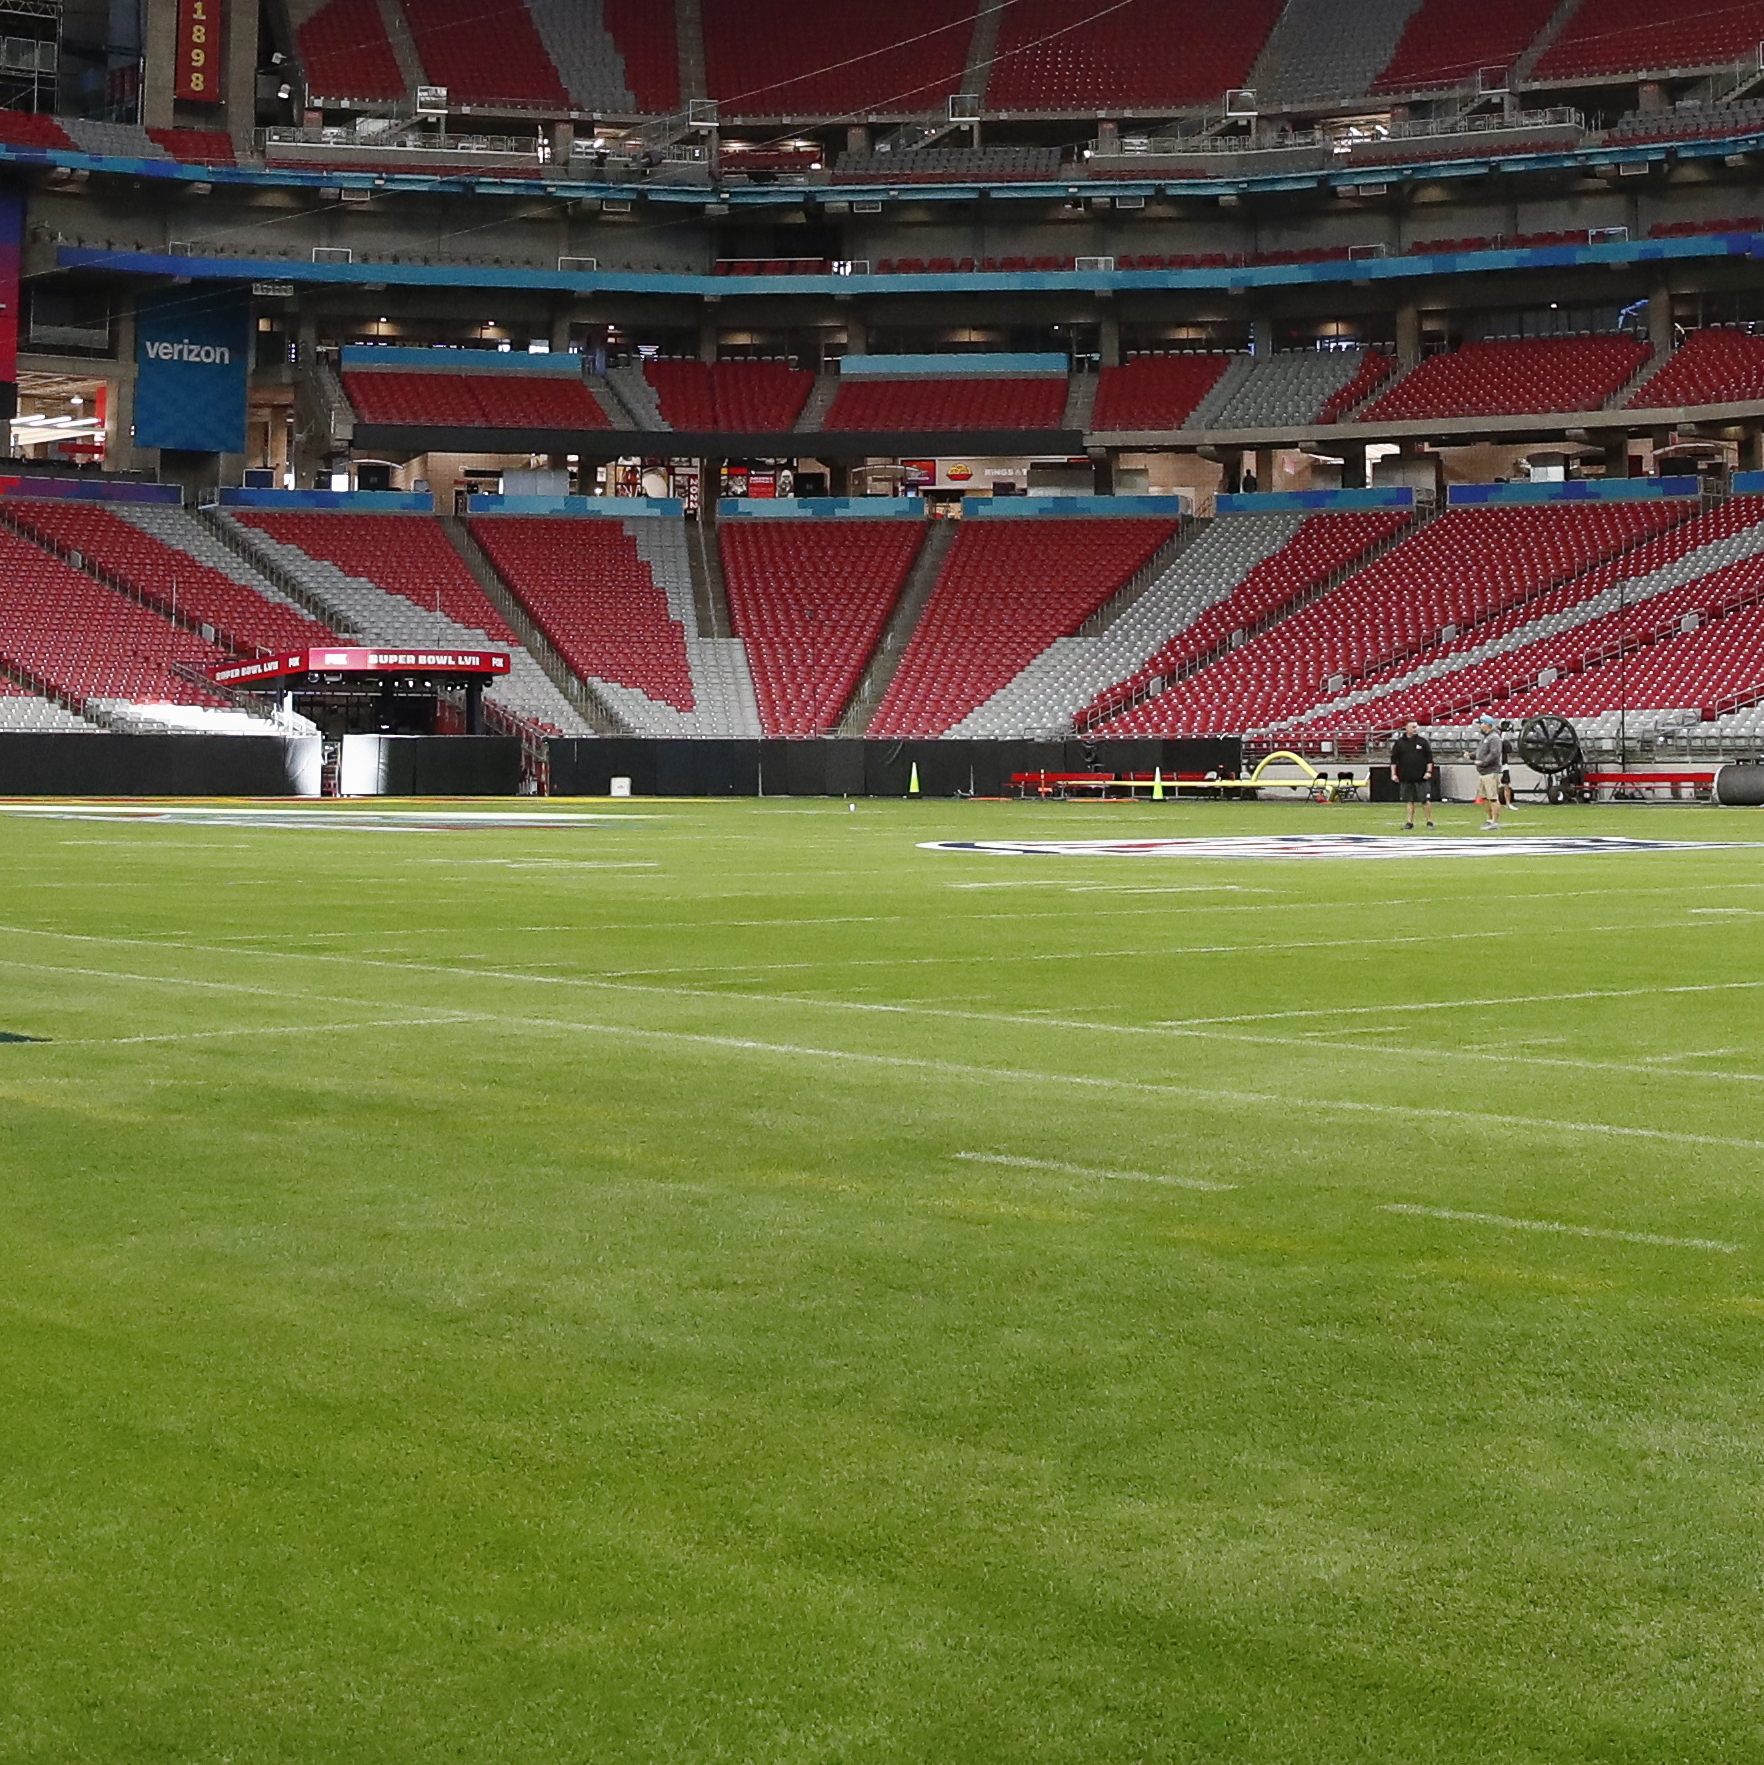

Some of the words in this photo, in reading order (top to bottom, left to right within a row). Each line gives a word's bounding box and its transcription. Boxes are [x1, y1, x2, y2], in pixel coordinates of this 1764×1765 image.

[187, 1, 208, 93] 1898
[144, 338, 230, 364] verizon
[689, 478, 699, 509] 2022
[215, 668, 240, 681] SUPER
[241, 664, 262, 676] BOWL
[368, 653, 416, 665] SUPER
[418, 654, 456, 665] BOWL
[457, 655, 480, 666] LVII
